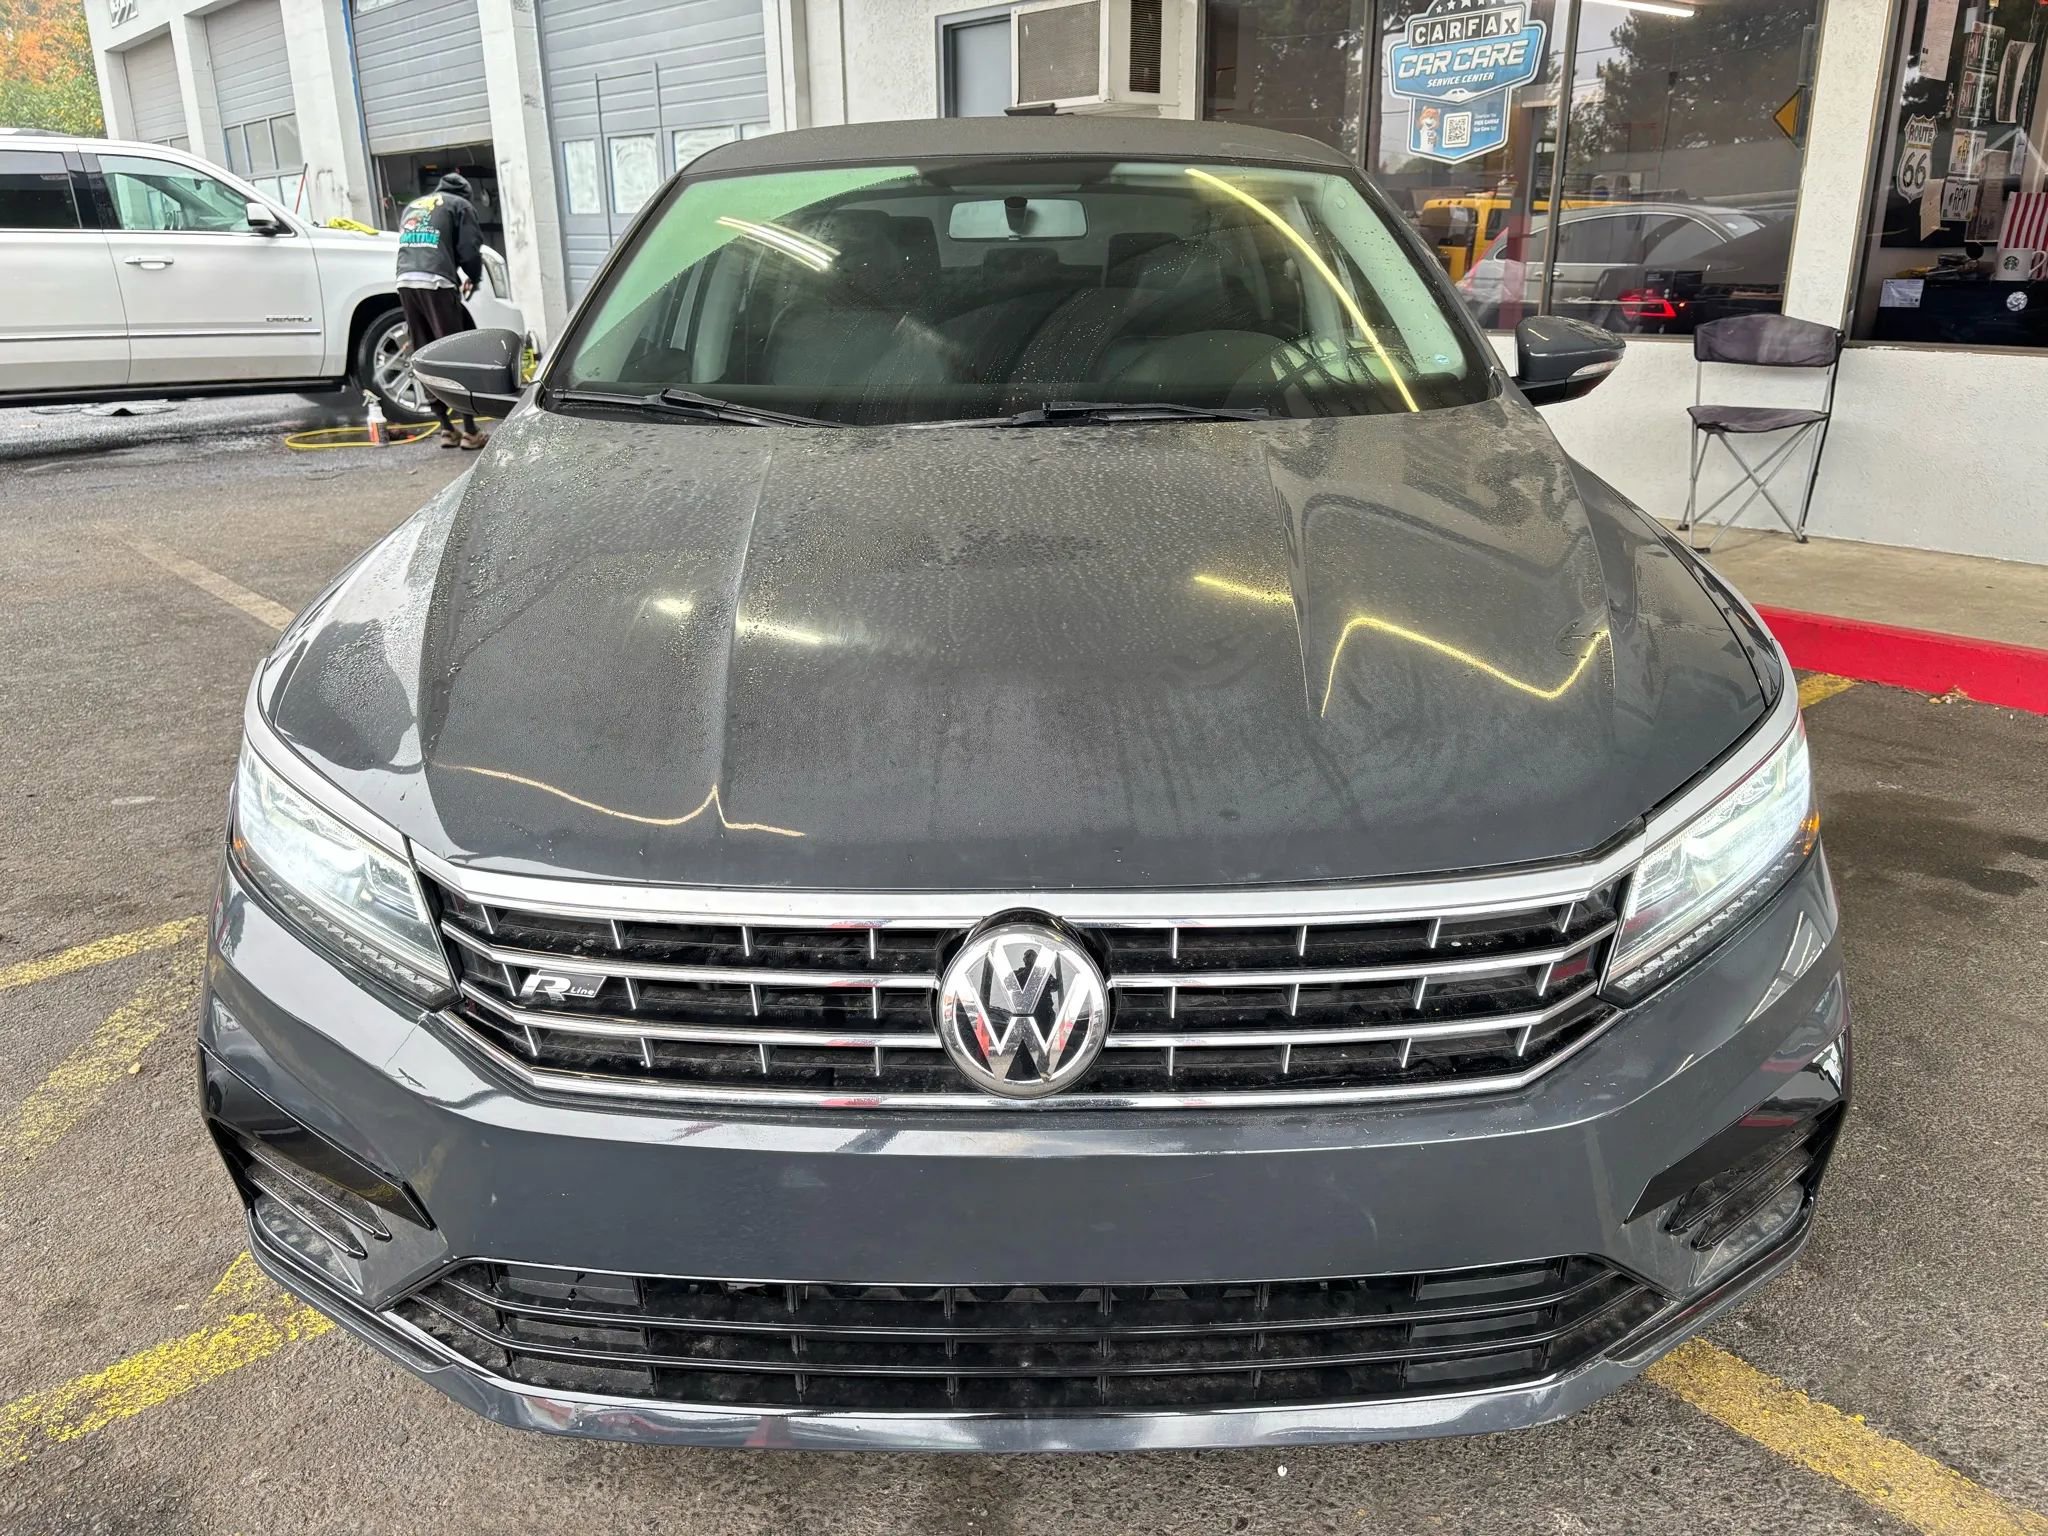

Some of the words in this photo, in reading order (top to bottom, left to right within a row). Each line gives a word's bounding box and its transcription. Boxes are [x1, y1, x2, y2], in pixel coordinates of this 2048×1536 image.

[1414, 16, 1518, 44] CARFAX
[1398, 50, 1453, 79] CAR
[1453, 40, 1529, 72] CARE
[1427, 75, 1461, 88] SERVICE
[1461, 72, 1495, 83] CENTER
[1909, 124, 1934, 143] ROUTE
[1902, 151, 1927, 189] 66
[519, 974, 572, 1001] R
[570, 986, 595, 996] Line
